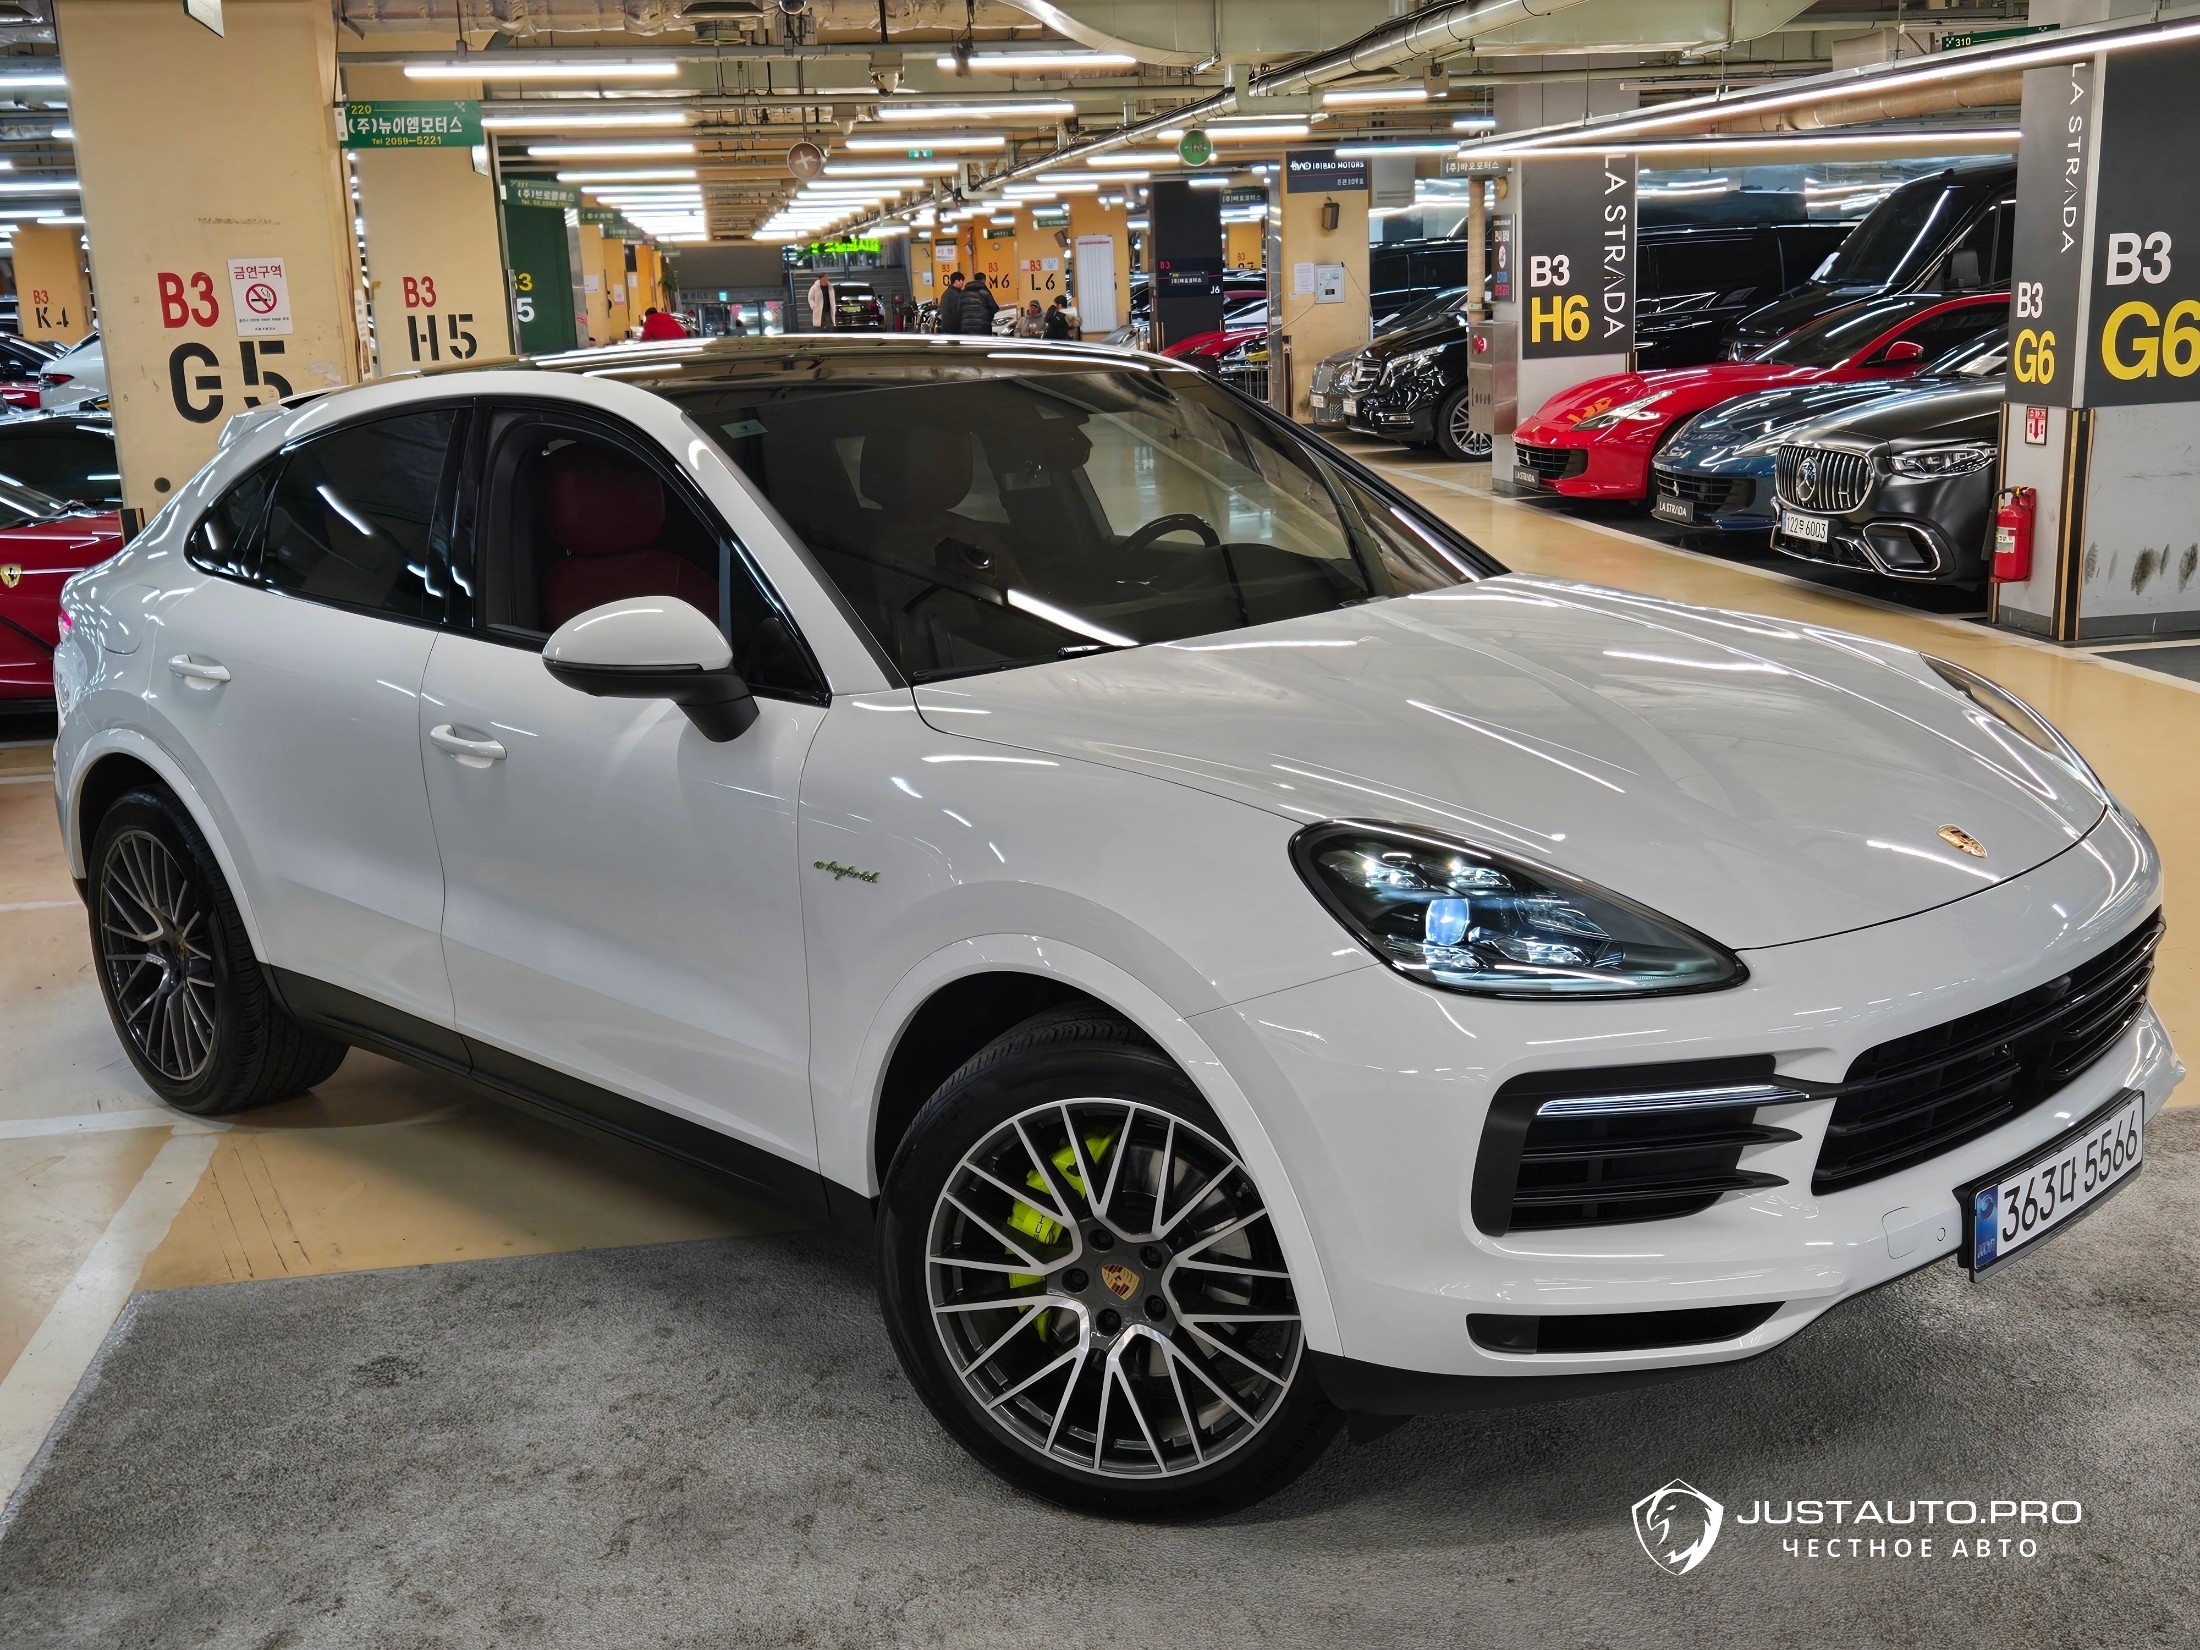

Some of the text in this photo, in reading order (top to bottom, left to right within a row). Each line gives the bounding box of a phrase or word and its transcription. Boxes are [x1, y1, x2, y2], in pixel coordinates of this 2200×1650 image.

[1955, 37, 1971, 47] 310
[348, 116, 463, 135] (주)뉴이엠모터스
[351, 105, 372, 115] 220
[2060, 62, 2087, 254] LA STRADA
[1603, 154, 1628, 339] LA STRADA
[2105, 231, 2172, 286] B3
[233, 265, 283, 280] 금연구역
[988, 262, 999, 273] B3
[1030, 260, 1042, 272] B3
[1530, 254, 1570, 288] B3
[33, 289, 49, 305] B3
[157, 271, 220, 329] B3
[402, 275, 437, 309] B3
[1210, 285, 1220, 295] J6
[2016, 281, 2044, 320] B3
[1530, 294, 1591, 343] H6
[2013, 328, 2056, 385] G6
[2101, 299, 2200, 381] G6
[1666, 503, 1687, 517] STRADA
[1805, 520, 1826, 539] 6003
[2084, 1109, 2138, 1193] 5566
